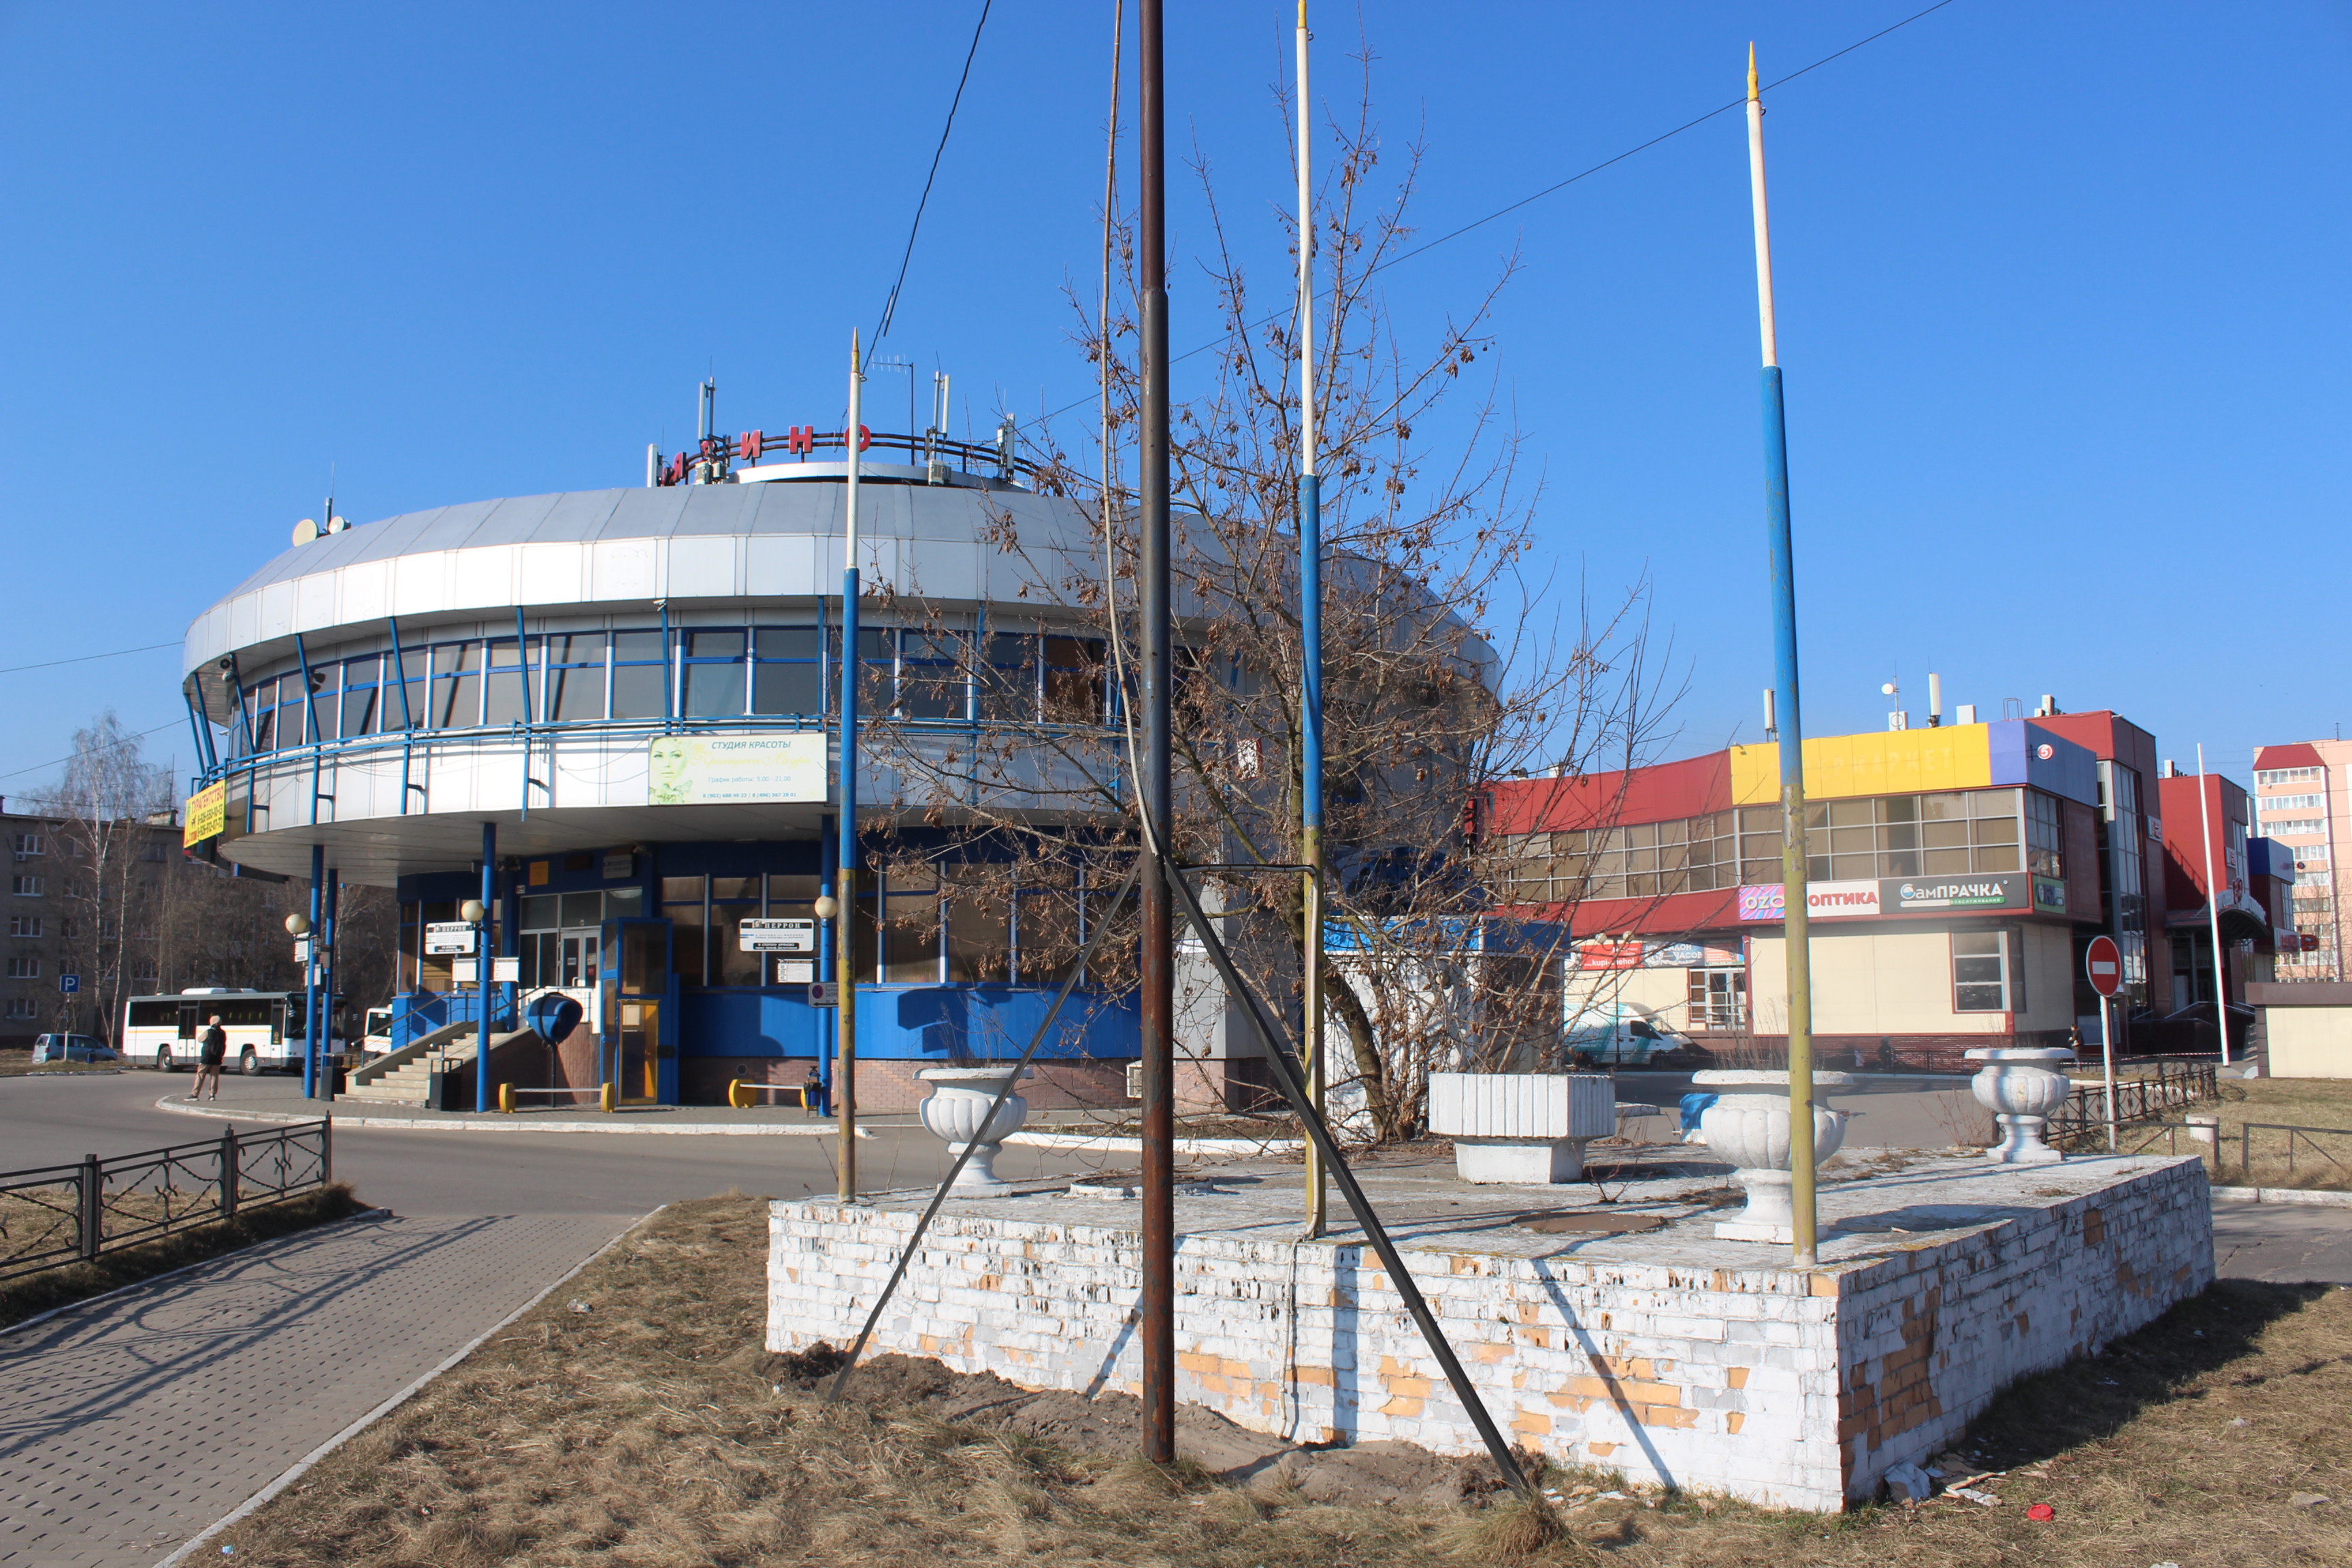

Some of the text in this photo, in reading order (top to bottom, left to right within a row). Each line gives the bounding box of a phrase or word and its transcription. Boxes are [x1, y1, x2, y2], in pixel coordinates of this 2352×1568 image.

[712, 740, 791, 750] СТУДИЯ КРАСОТЫ
[1745, 894, 1785, 910] OZO
[1808, 892, 1878, 906] ОПТИКА
[1673, 951, 1703, 960] ЧАСОВ
[65, 977, 76, 991] P
